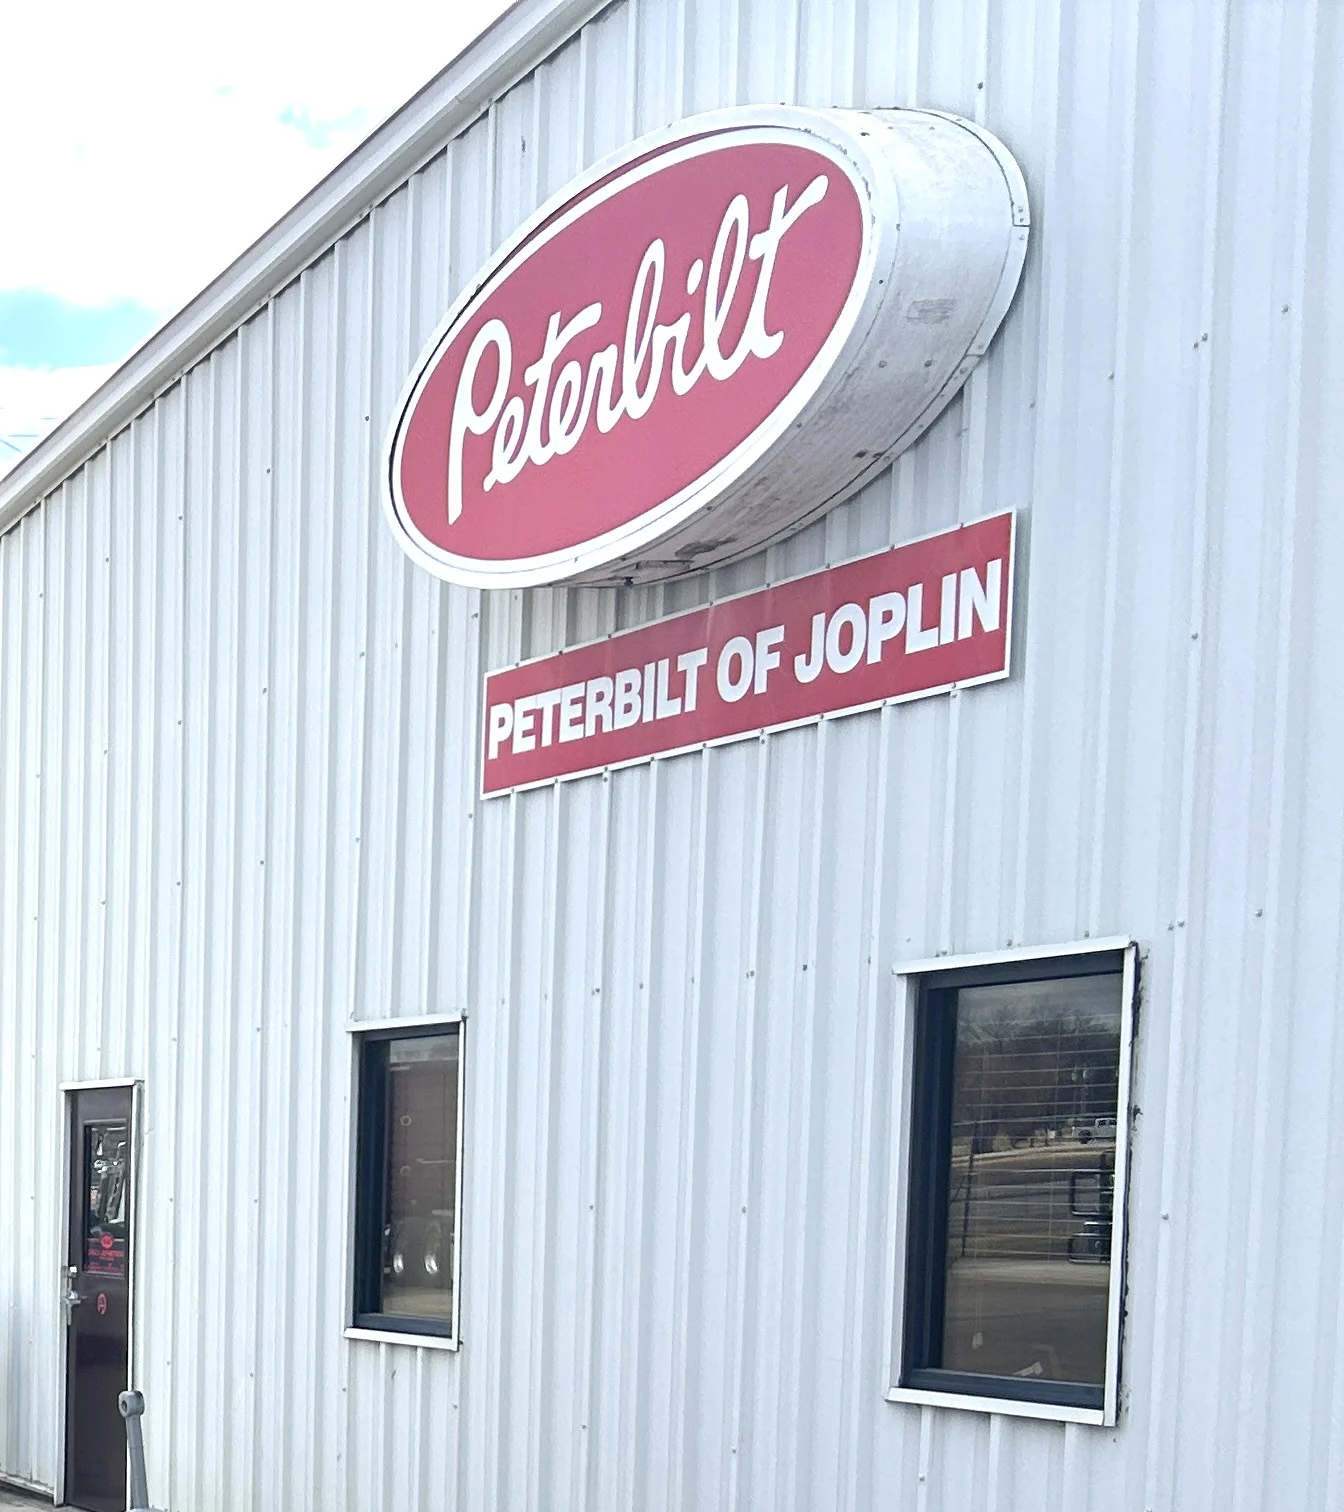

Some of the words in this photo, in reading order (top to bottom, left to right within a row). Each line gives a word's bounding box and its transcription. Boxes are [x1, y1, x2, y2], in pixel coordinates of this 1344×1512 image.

[448, 174, 830, 526] Peterbilt
[488, 647, 708, 760] PETERBILT
[717, 625, 784, 703] OF
[794, 558, 1002, 684] JOPLIN
